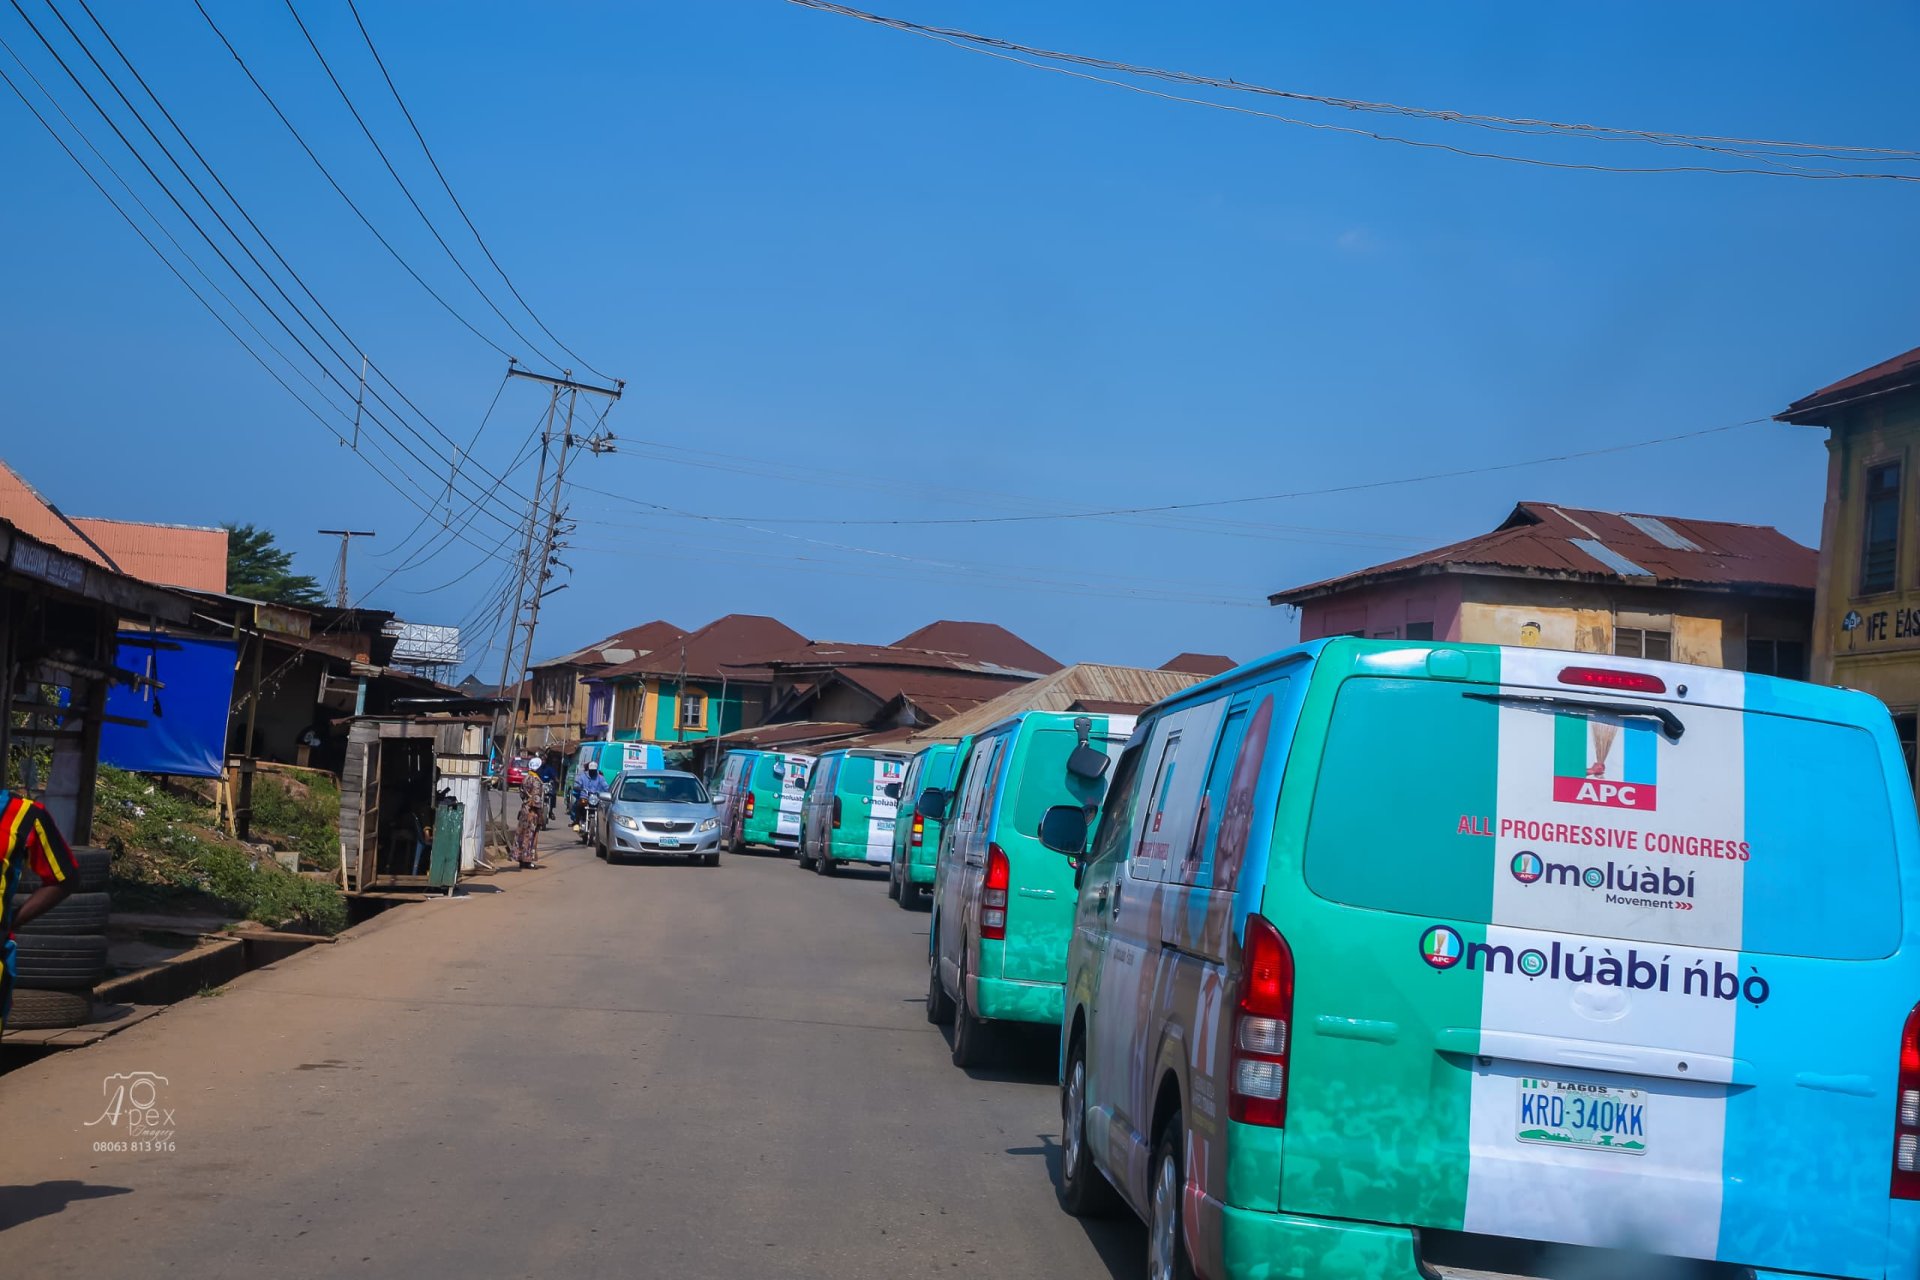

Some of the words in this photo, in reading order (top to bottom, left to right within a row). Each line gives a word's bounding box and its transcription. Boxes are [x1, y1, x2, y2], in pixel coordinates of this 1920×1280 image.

[1867, 611, 1889, 642] IFE
[1576, 782, 1636, 806] APC
[1457, 815, 1494, 837] ALL
[1501, 819, 1638, 850] PROGRESSIVE
[1644, 832, 1751, 862] CONGRESS
[1606, 893, 1674, 910] Movement
[1556, 1082, 1608, 1094] LAGOS
[1521, 1093, 1643, 1137] KRD-340KK
